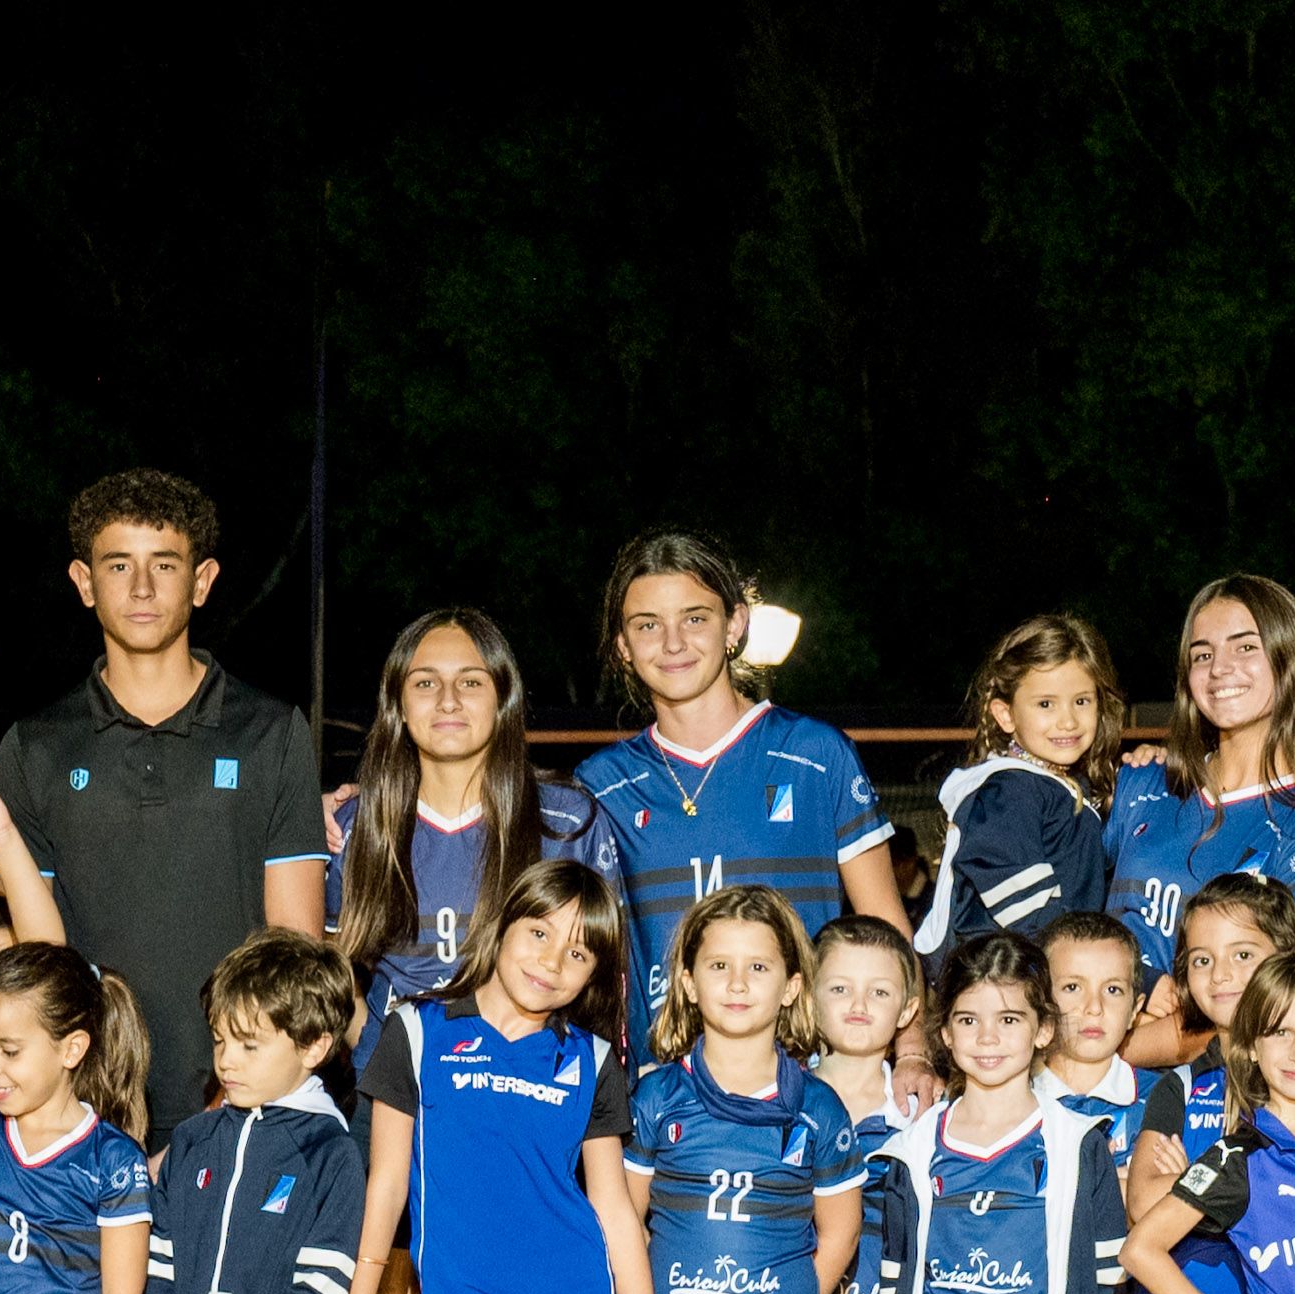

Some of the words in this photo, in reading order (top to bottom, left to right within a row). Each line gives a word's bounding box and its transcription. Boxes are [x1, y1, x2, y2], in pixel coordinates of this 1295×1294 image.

[690, 855, 723, 904] 14
[1139, 877, 1182, 938] 30
[436, 907, 457, 963] 9
[473, 1073, 570, 1106] INTERSPORT
[706, 1168, 754, 1222] 22
[7, 1210, 29, 1264] 8
[729, 1267, 781, 1292] Cuba
[929, 1258, 981, 1285] Enjoy
[981, 1260, 1033, 1287] Cuba
